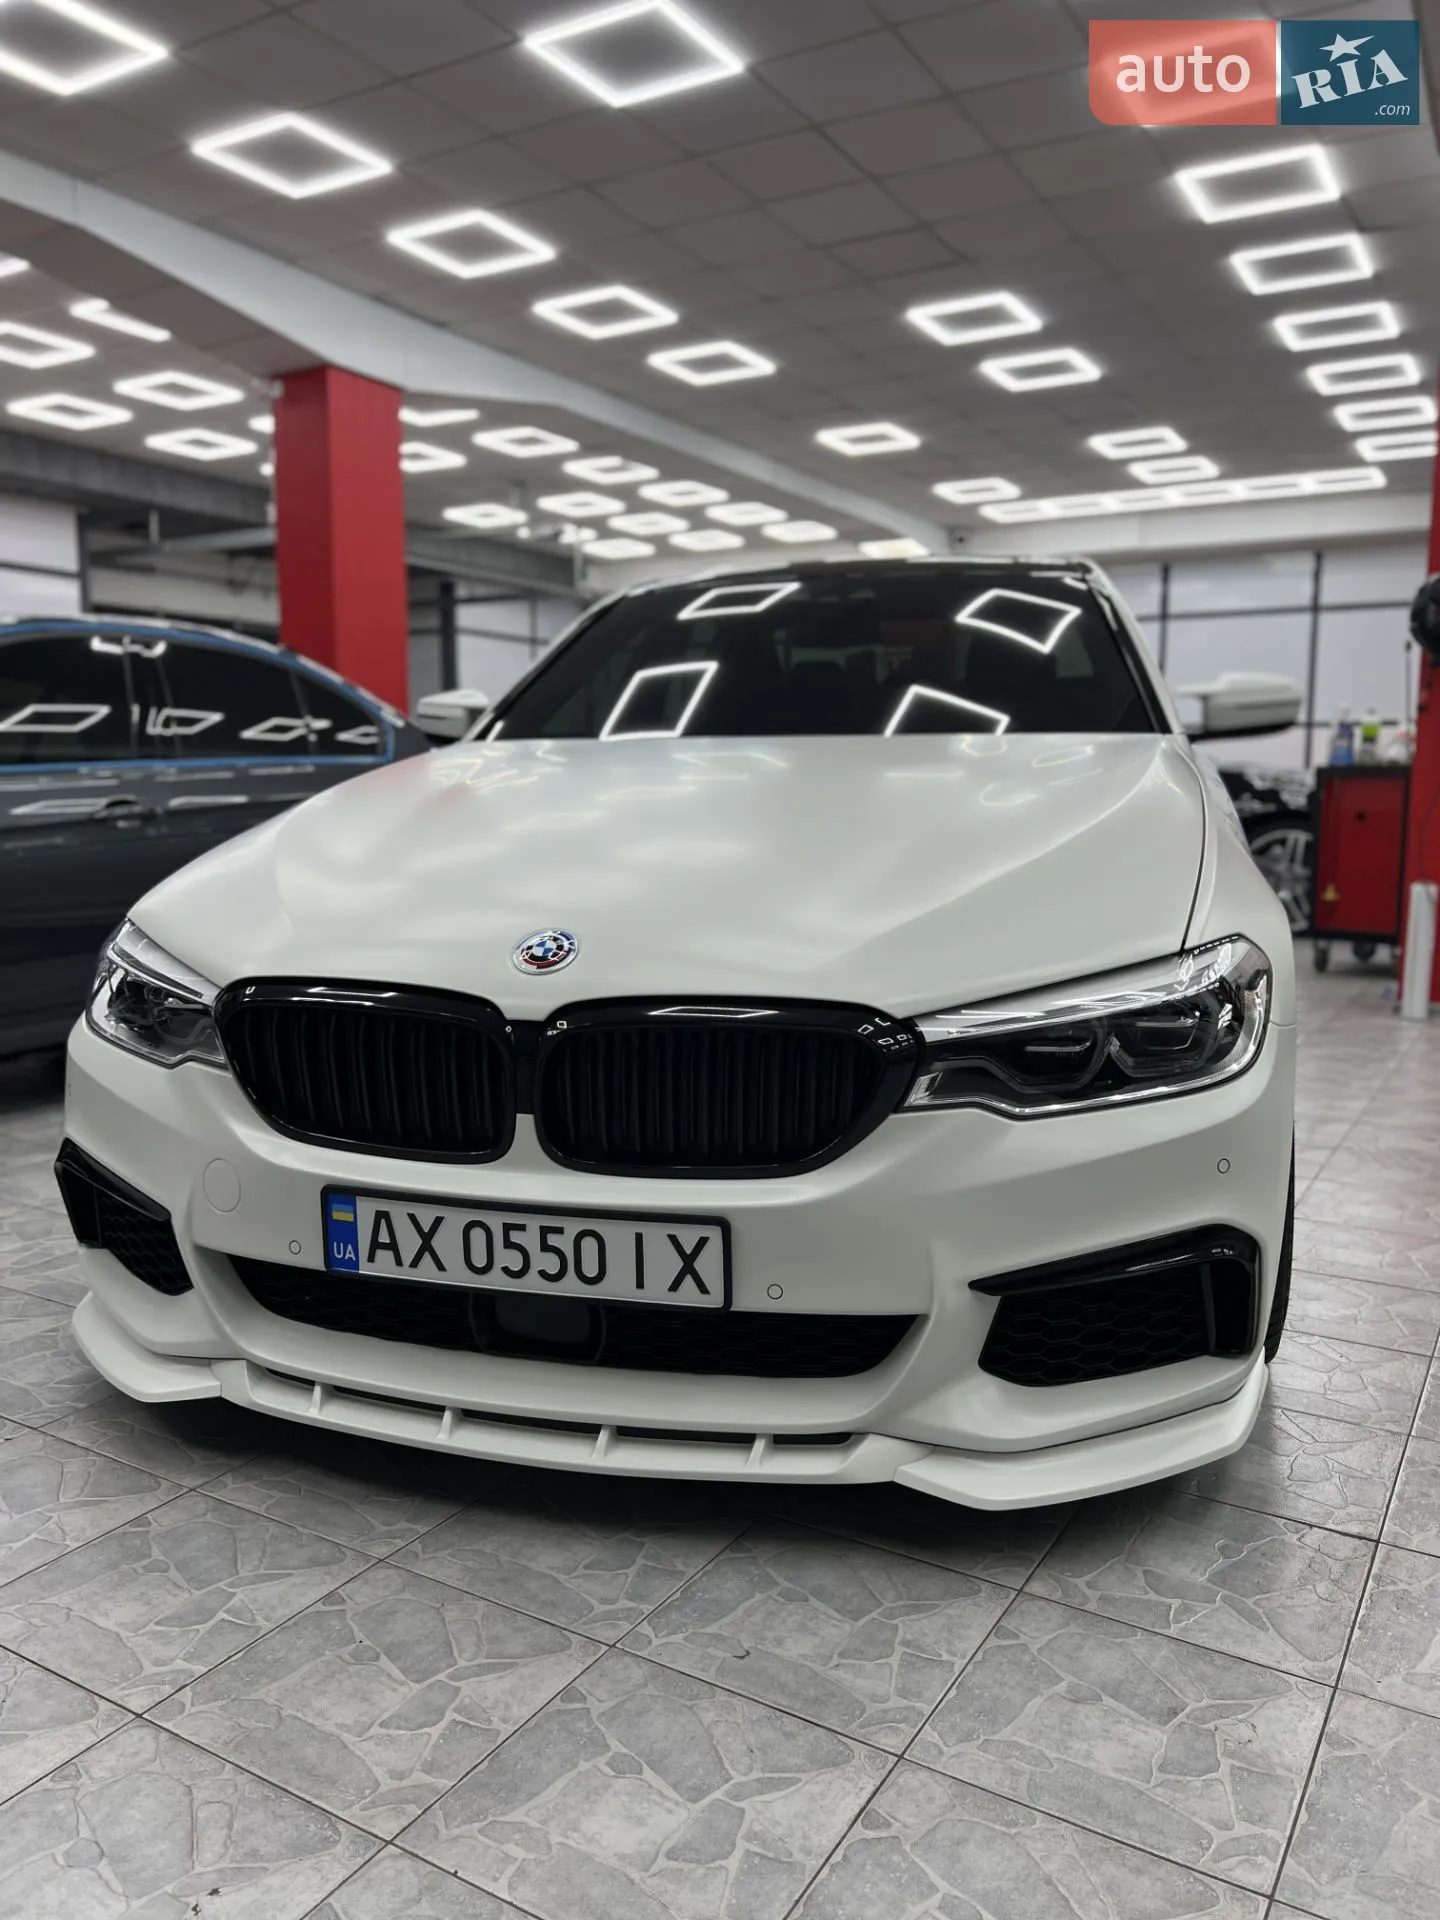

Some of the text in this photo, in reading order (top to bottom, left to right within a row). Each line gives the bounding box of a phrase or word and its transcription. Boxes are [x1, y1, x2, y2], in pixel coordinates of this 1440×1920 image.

[333, 1241, 356, 1261] UA
[367, 1210, 711, 1295] AX 0550 IX
